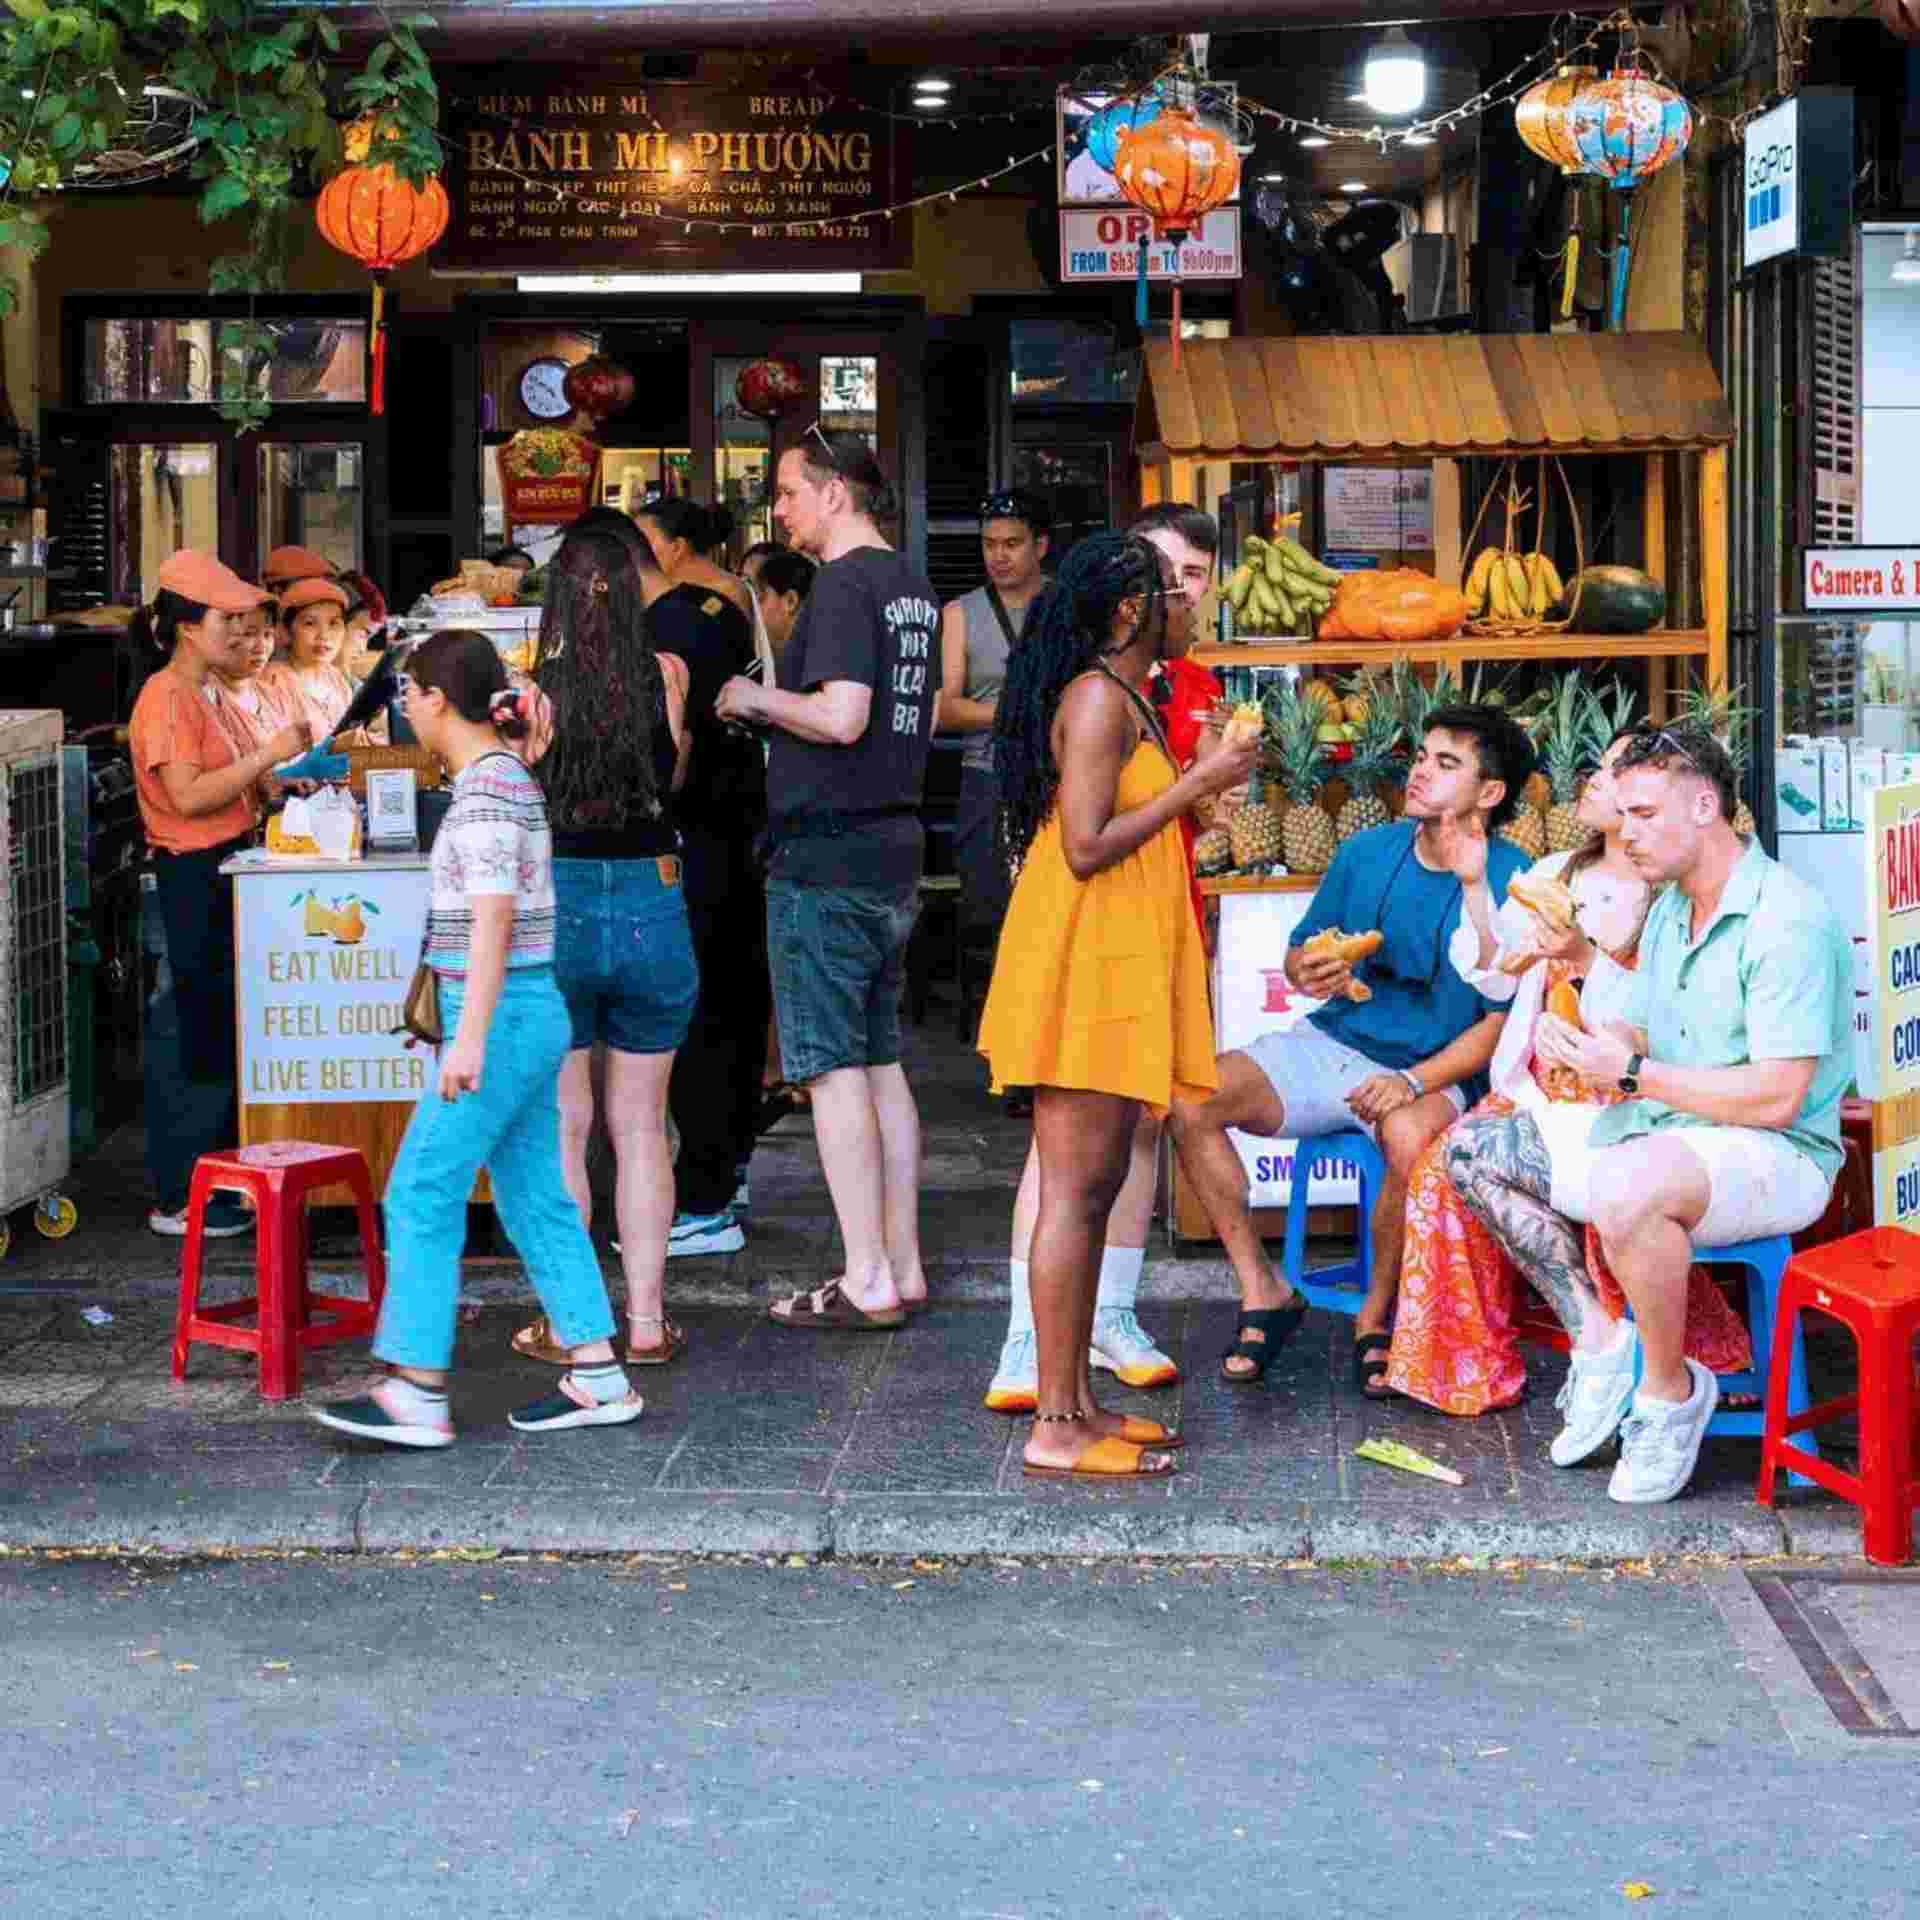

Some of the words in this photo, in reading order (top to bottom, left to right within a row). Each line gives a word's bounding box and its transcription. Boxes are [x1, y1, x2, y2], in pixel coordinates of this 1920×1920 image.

[750, 95, 825, 115] BREAD
[1747, 144, 1794, 189] GoPro
[1096, 214, 1206, 244] OP
[1072, 252, 1107, 272] FROM
[1810, 560, 1884, 596] Camera
[1890, 559, 1905, 596] &
[267, 950, 321, 982] EAT
[330, 949, 404, 981] WELL
[263, 1003, 328, 1038] FEEL
[252, 1056, 312, 1092] LIVE
[319, 1056, 425, 1092] BETTER
[1256, 1155, 1357, 1182] SMOTH
